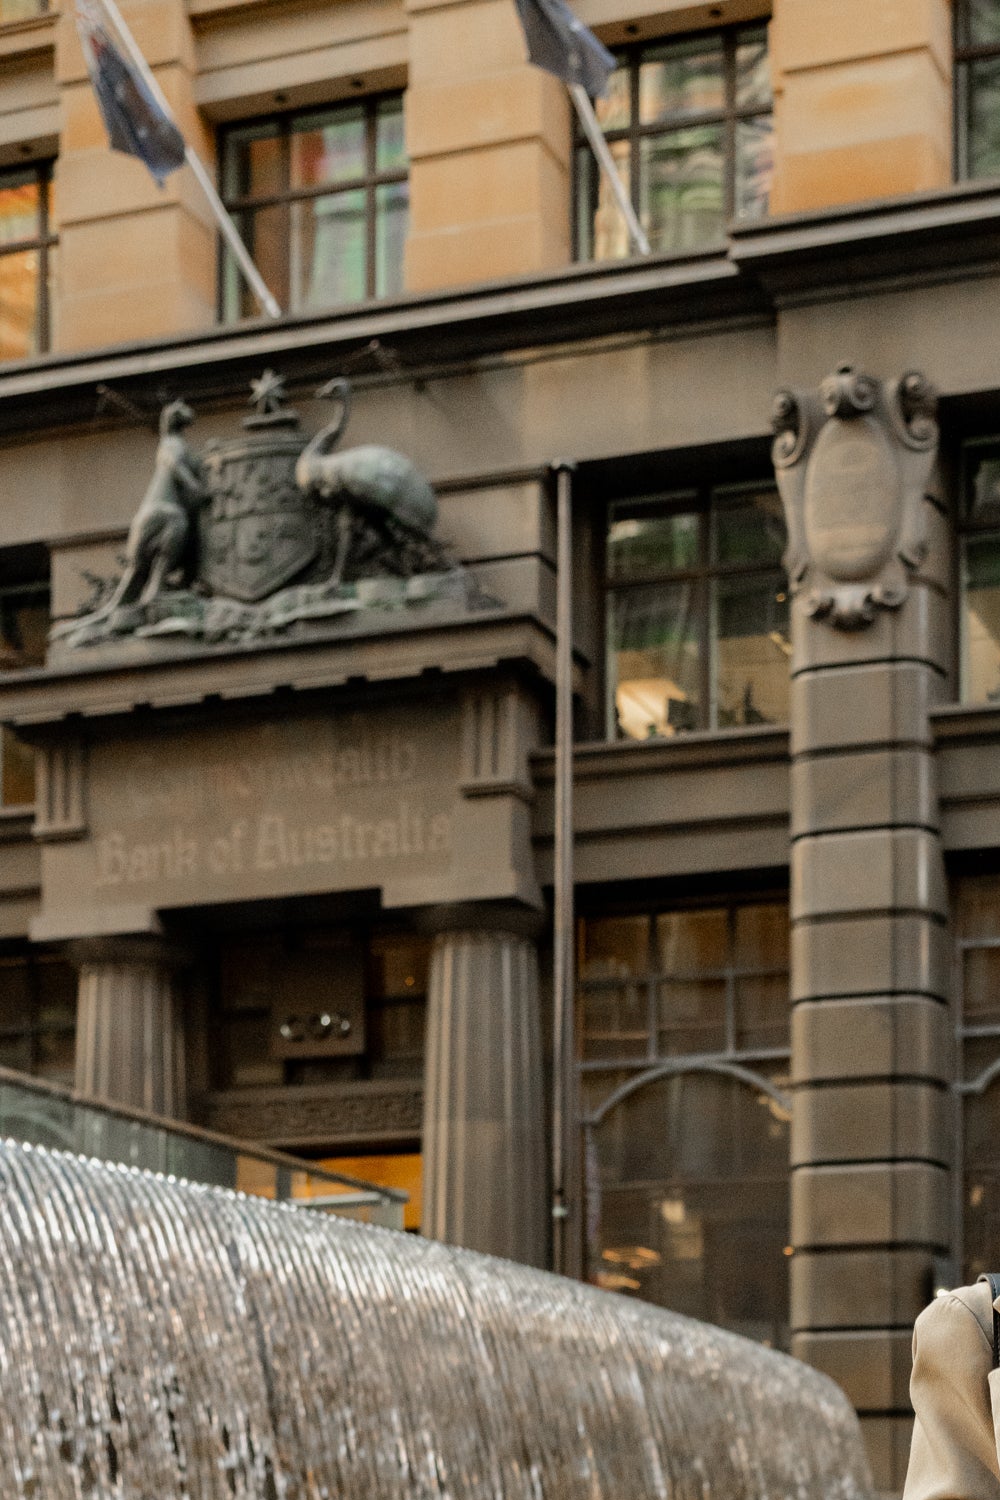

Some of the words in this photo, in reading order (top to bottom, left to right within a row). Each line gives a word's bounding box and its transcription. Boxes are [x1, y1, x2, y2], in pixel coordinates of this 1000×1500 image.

[95, 828, 198, 886] Bank
[208, 817, 249, 874] of
[253, 800, 453, 870] Australia
